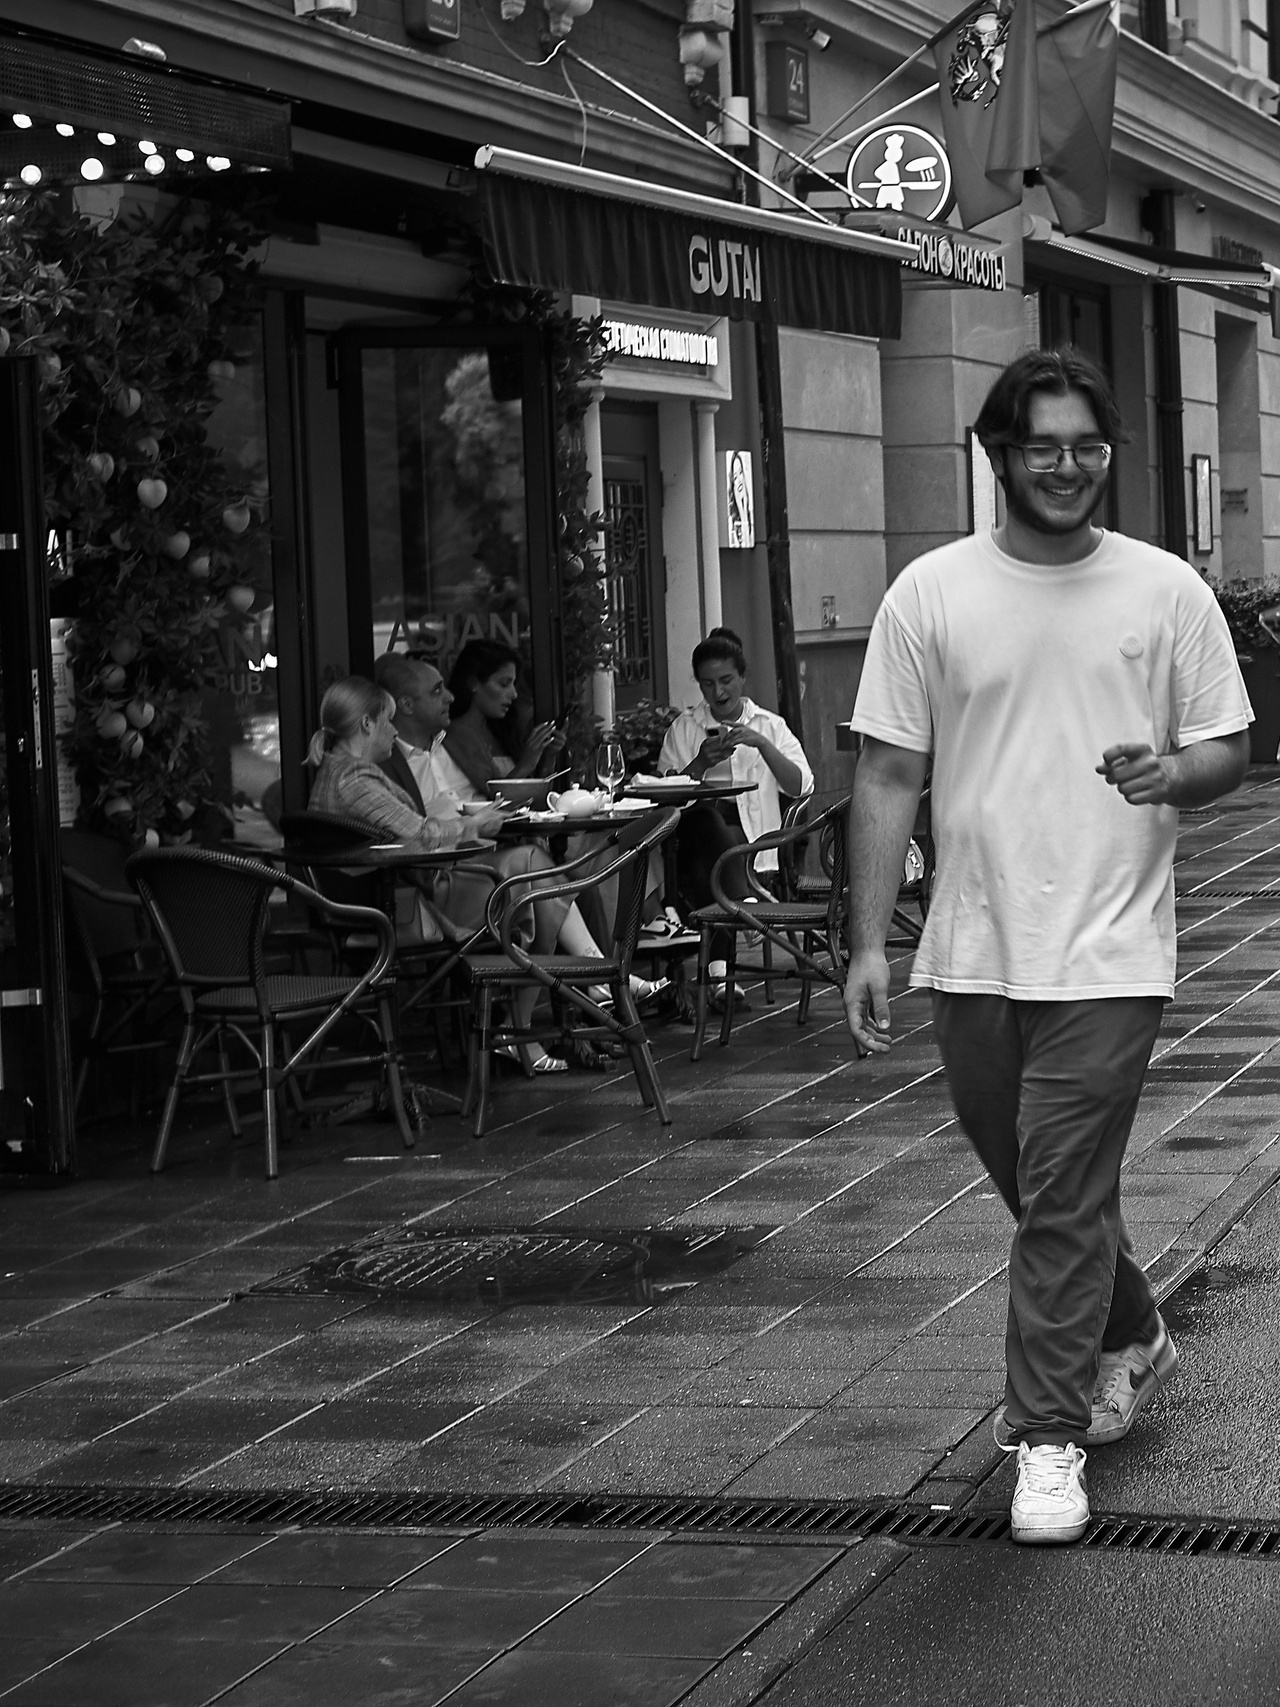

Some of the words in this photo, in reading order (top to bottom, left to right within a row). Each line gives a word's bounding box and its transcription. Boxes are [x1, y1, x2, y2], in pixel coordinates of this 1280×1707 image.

[789, 59, 804, 94] 24
[689, 235, 761, 302] GUTAI
[953, 242, 1006, 290] КРАСОТЫ
[387, 611, 519, 652] ASIAN
